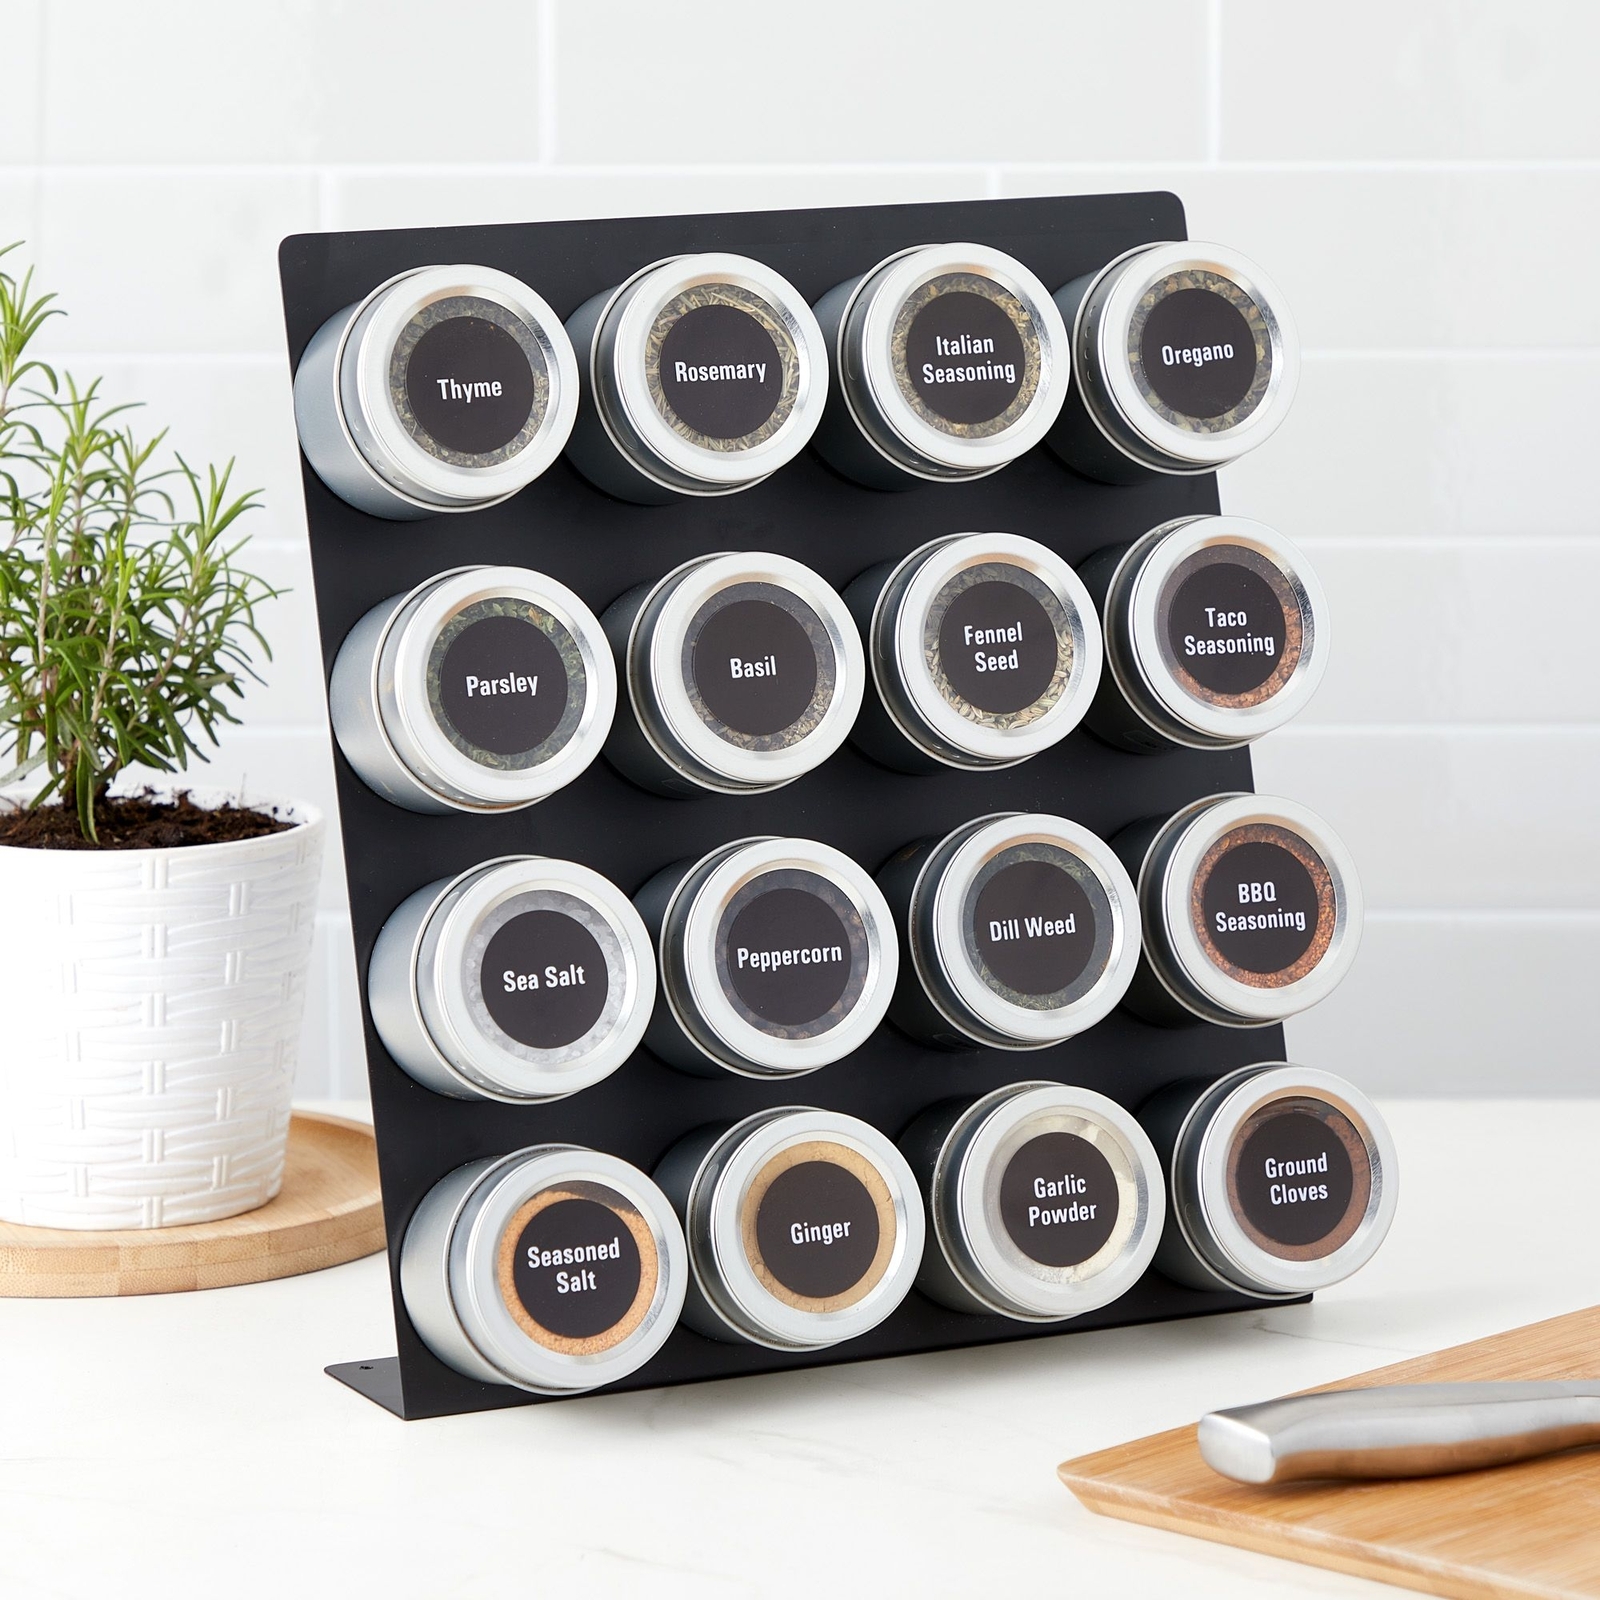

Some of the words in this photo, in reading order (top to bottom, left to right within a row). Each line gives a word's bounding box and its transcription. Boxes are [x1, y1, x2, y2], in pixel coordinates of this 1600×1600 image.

[935, 334, 996, 357] Italian
[1161, 343, 1235, 368] Oregano
[674, 361, 768, 385] Rosemary
[922, 360, 1017, 385] Seasoning
[436, 378, 504, 404] Thyme
[1204, 607, 1248, 628] Taco
[963, 621, 1023, 646] Fennel
[1184, 632, 1276, 657] Seasoning
[729, 654, 777, 680] Basil
[974, 648, 1020, 673] Seed
[465, 671, 539, 698] Parsley
[1237, 881, 1277, 904] BBQ
[989, 918, 1021, 942] Dill
[1023, 912, 1076, 938] Weed
[1215, 907, 1306, 933] Seasoning
[736, 944, 843, 973] Peppercorn
[502, 969, 540, 993] Sea
[544, 963, 586, 988] Salt
[1264, 1151, 1329, 1179] Ground
[1033, 1173, 1087, 1199] Garlic
[1269, 1182, 1330, 1206] Cloves
[1028, 1198, 1098, 1228] Powder
[790, 1220, 852, 1246] Ginger
[527, 1236, 621, 1269] Seasoned
[555, 1268, 598, 1294] Salt
